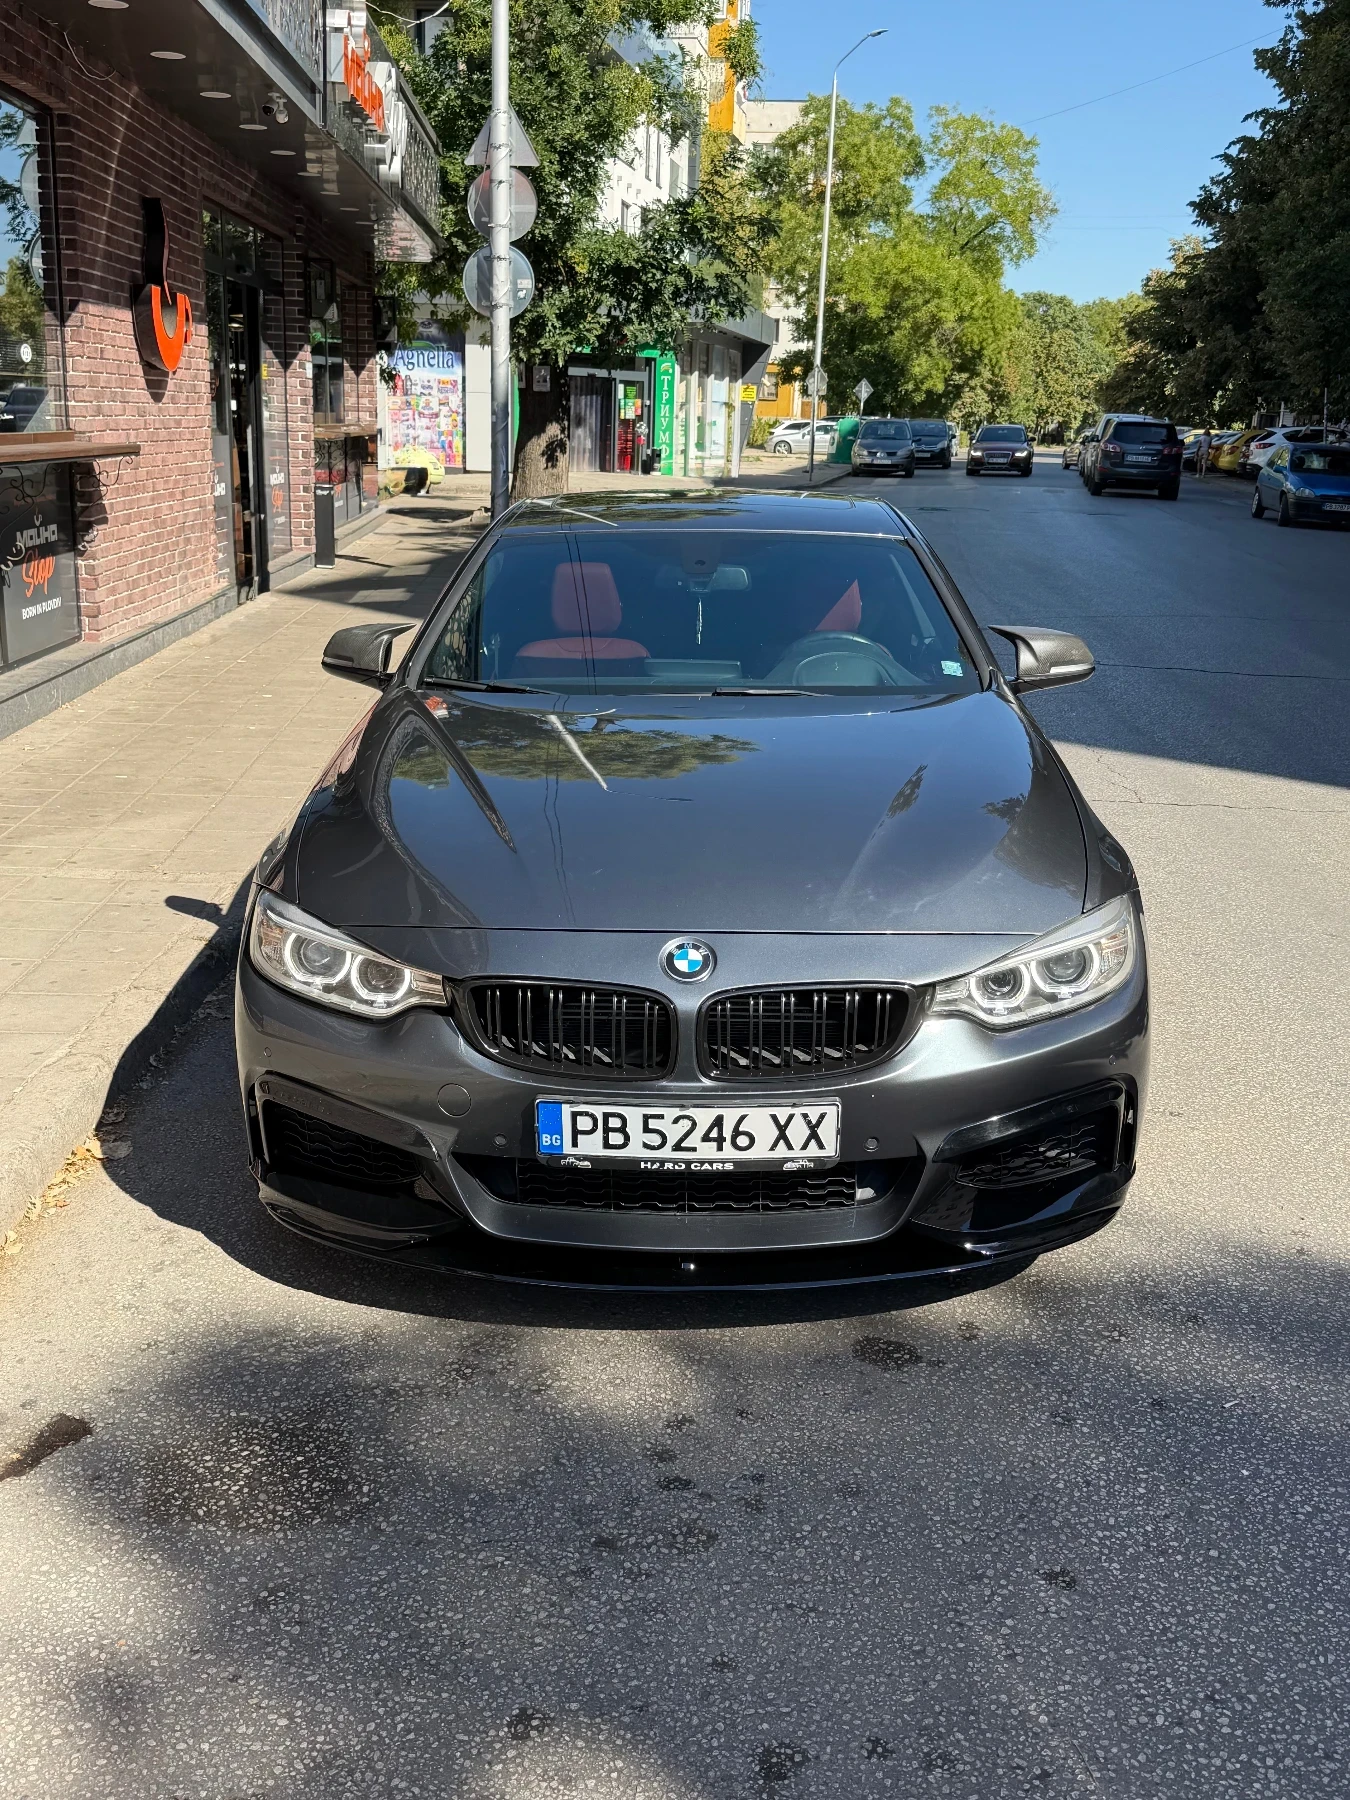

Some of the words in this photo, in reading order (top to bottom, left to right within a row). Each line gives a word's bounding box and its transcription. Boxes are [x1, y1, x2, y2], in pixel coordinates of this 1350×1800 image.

[394, 343, 454, 371] Agnella
[658, 376, 671, 458] ТРИУМФ
[22, 548, 55, 597] Stop
[22, 605, 36, 620] BORN
[670, 943, 709, 955] BMW
[542, 1134, 561, 1146] BG
[571, 1110, 631, 1150] PB
[642, 1113, 756, 1152] 5246
[768, 1111, 828, 1152] XX
[691, 1162, 734, 1170] CARS
